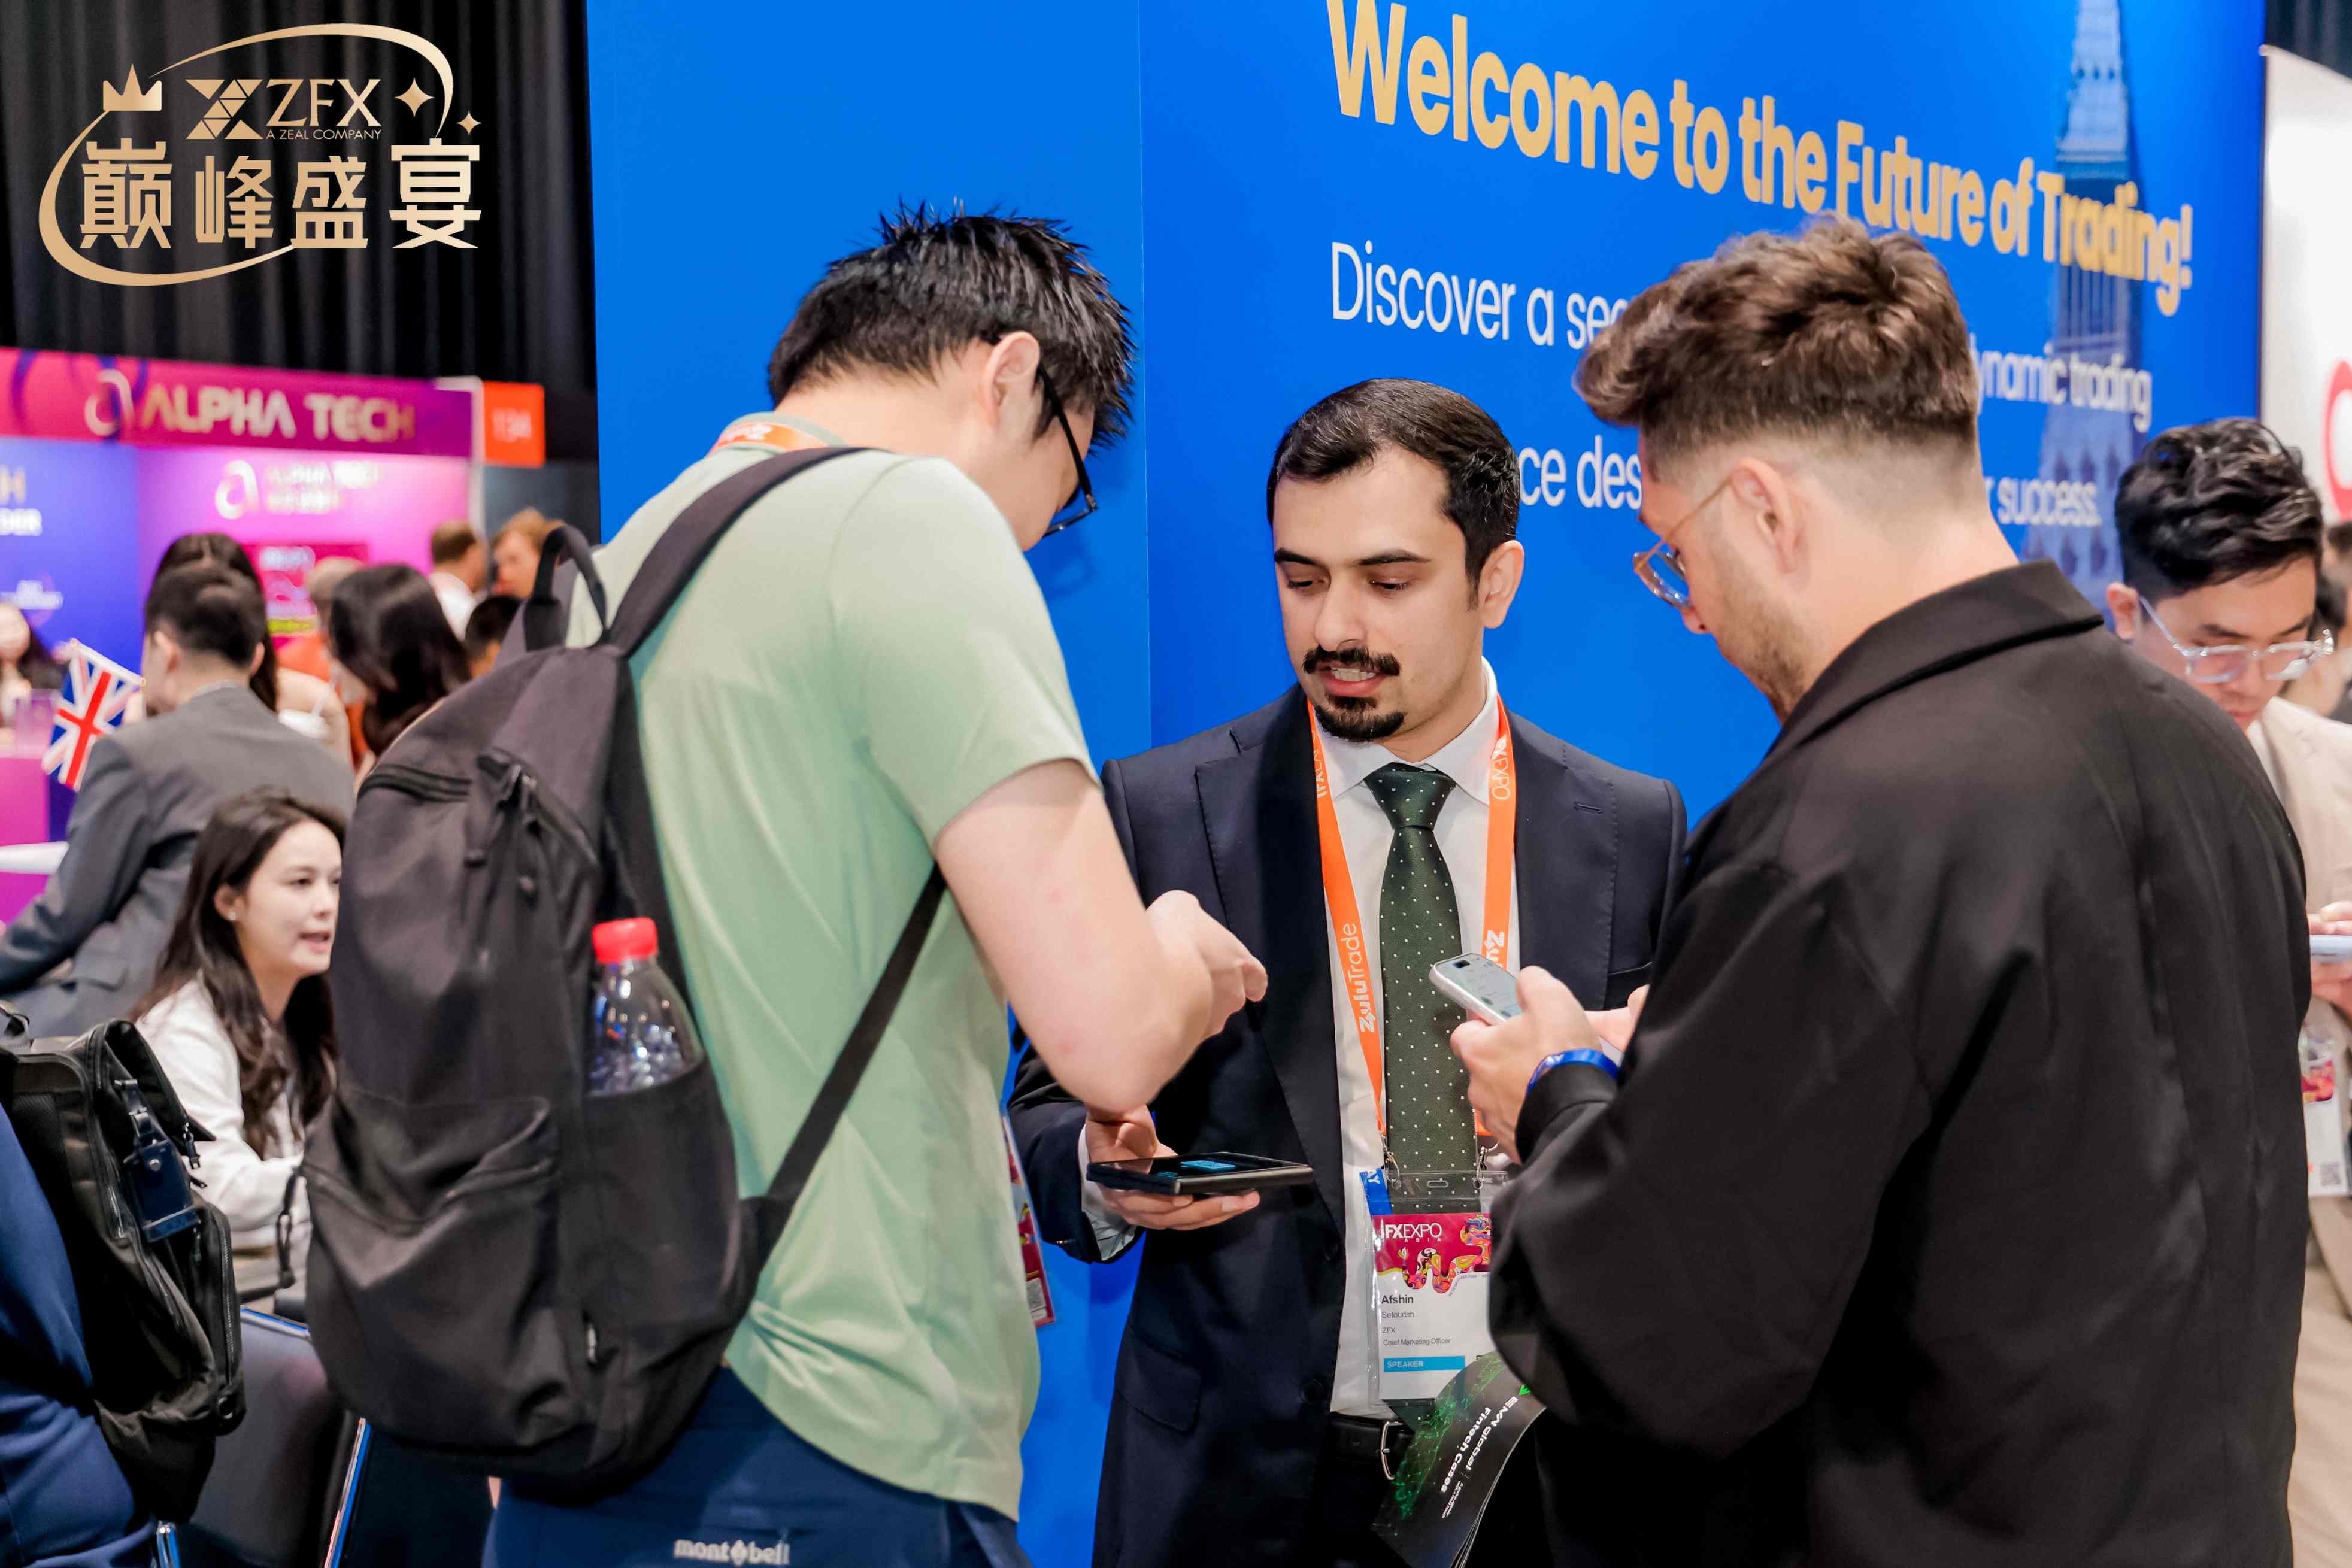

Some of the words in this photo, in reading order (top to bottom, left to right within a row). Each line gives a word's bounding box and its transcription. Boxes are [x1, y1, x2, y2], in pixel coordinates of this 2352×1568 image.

[1327, 0, 1660, 180] Welcome
[1670, 78, 1730, 195] to
[1738, 95, 1827, 215] the
[1836, 119, 1986, 247] Future
[1990, 156, 2035, 257] of
[2036, 170, 2194, 317] Trading!
[1332, 240, 1517, 341] Discover
[1527, 287, 1554, 347] a
[140, 384, 298, 439] ALPHA
[303, 392, 417, 444] TECH
[1519, 447, 1567, 507] ce
[1576, 434, 1642, 510] des
[1341, 923, 1376, 1033] ZuluTrade
[1381, 1294, 1414, 1305] Afshin
[1387, 1360, 1424, 1369] SPEAKER
[1401, 1337, 1430, 1346] Marketing
[1459, 1407, 1492, 1451] Fintech
